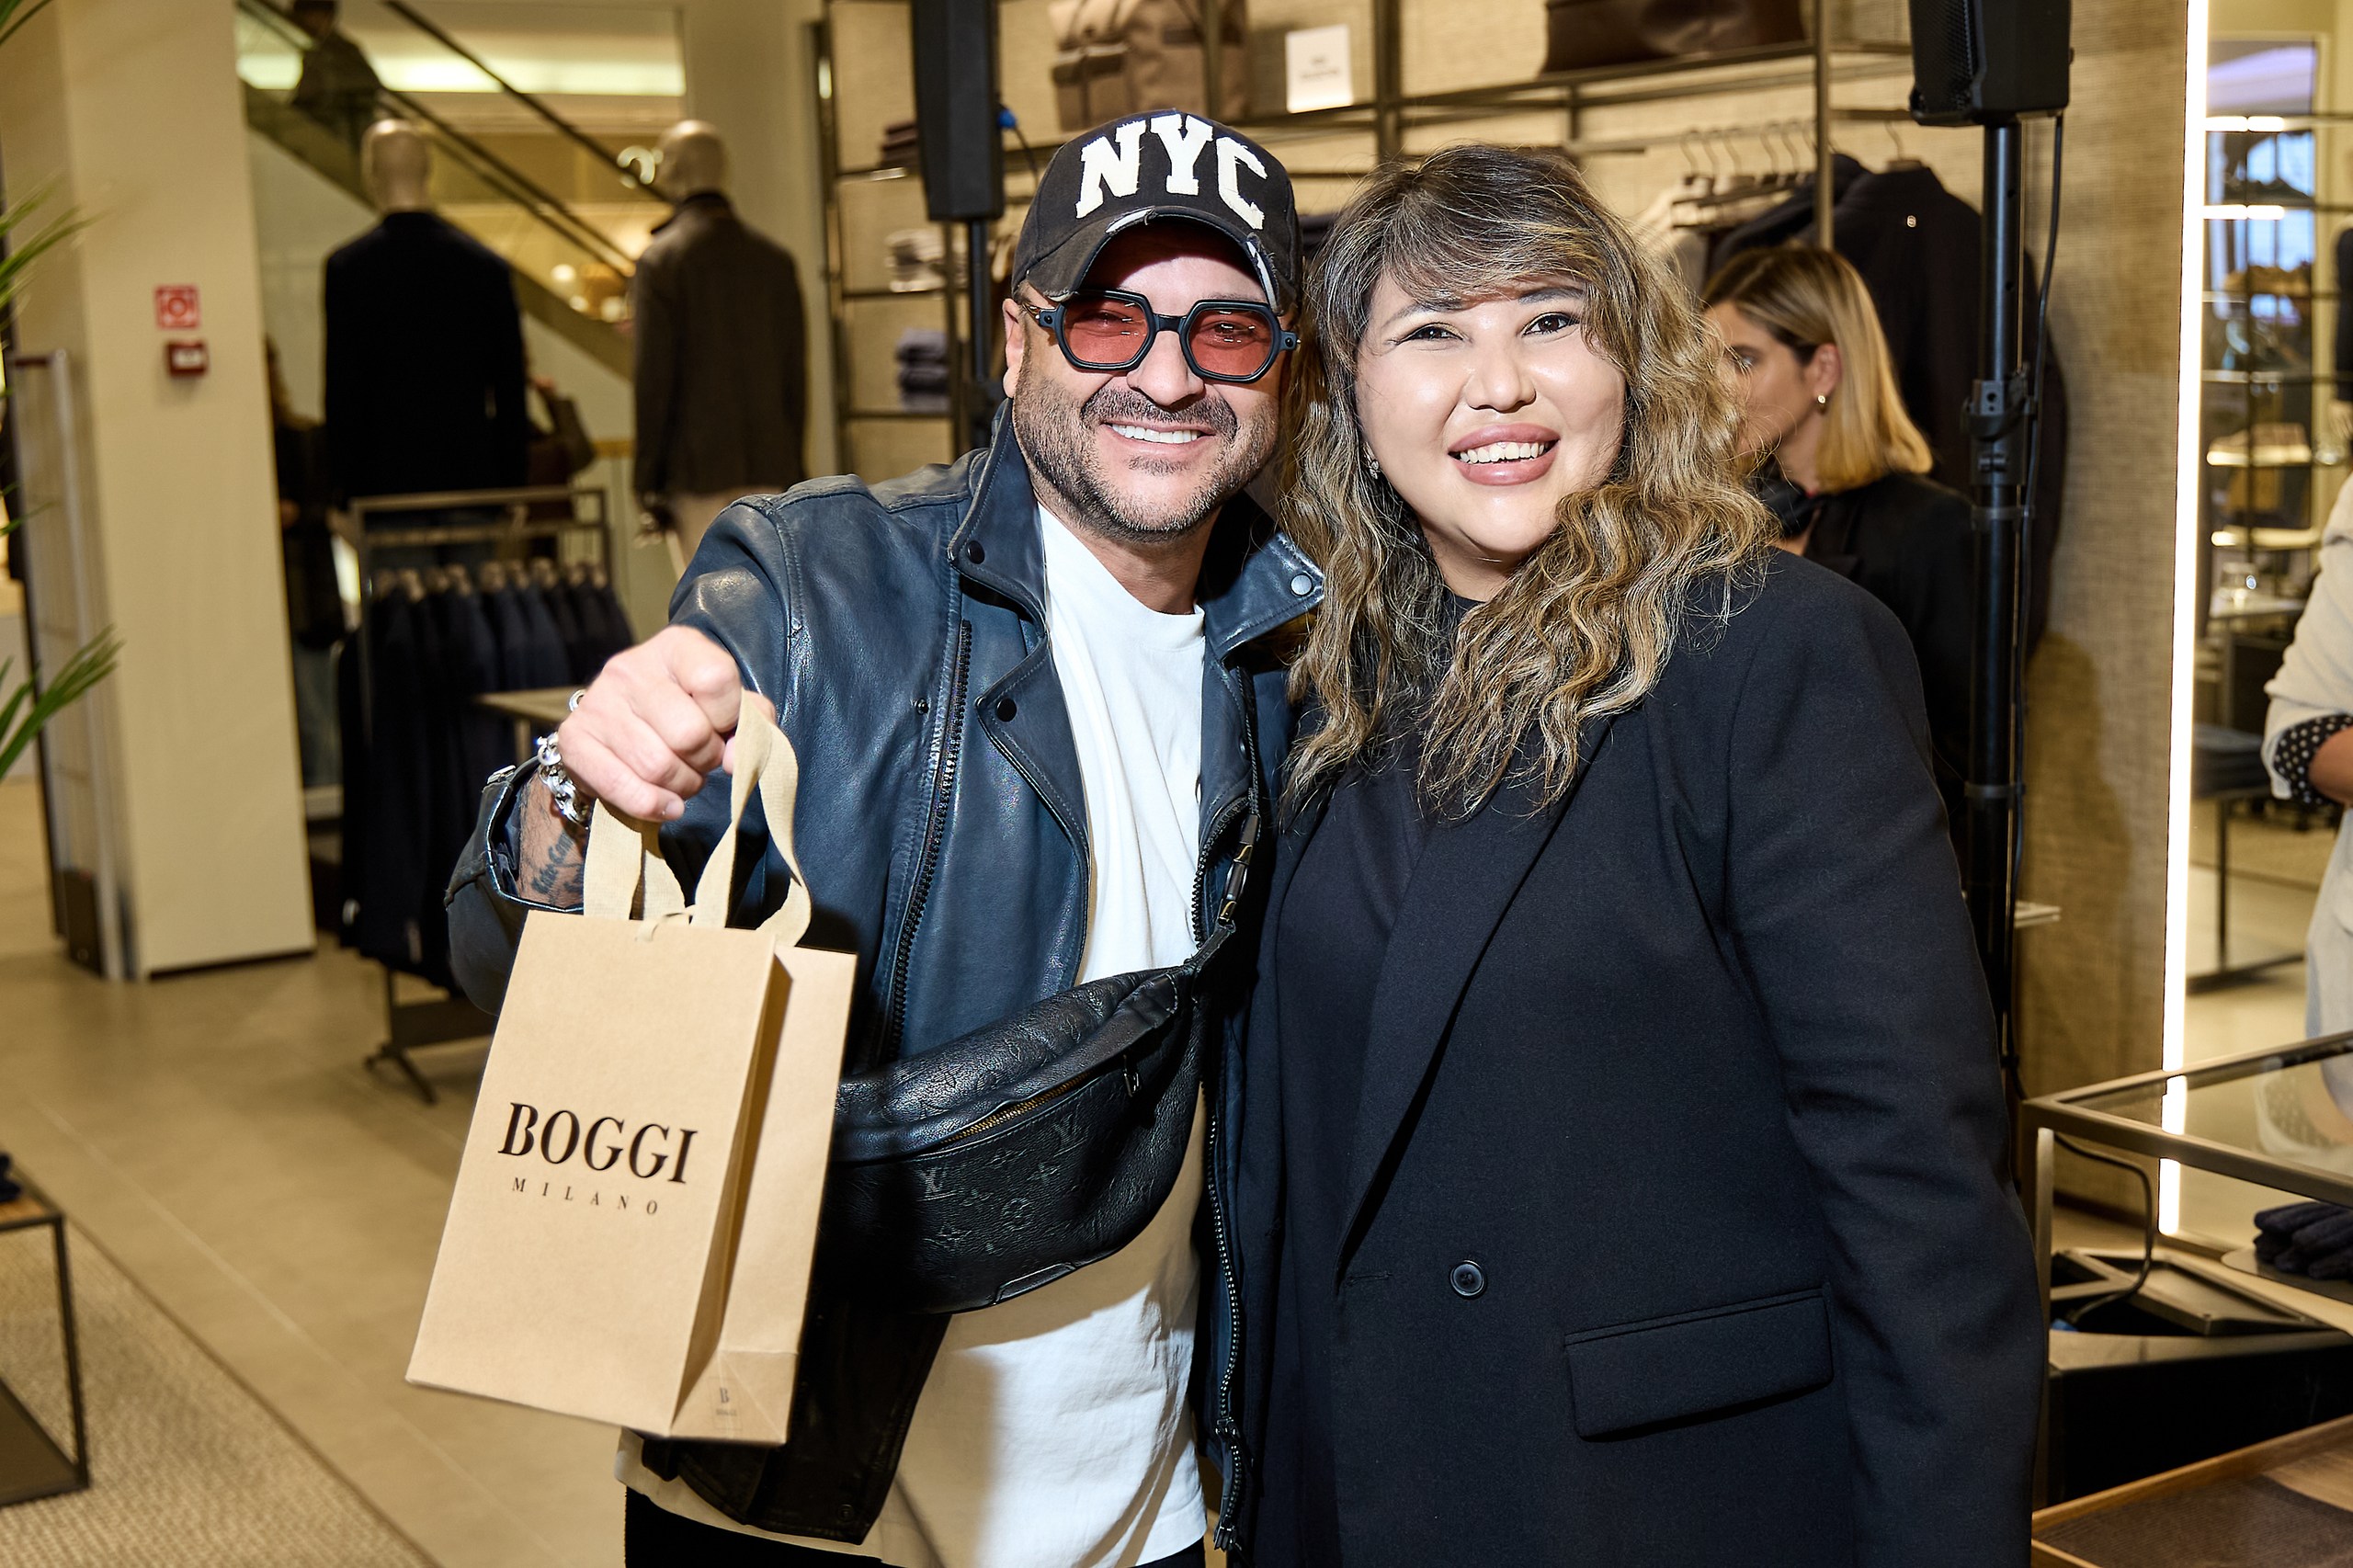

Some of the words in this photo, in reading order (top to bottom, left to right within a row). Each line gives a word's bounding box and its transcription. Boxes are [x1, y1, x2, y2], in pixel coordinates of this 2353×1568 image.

[1075, 113, 1267, 230] NYC
[497, 1102, 699, 1184] BOGGI
[511, 1176, 658, 1215] MILANO
